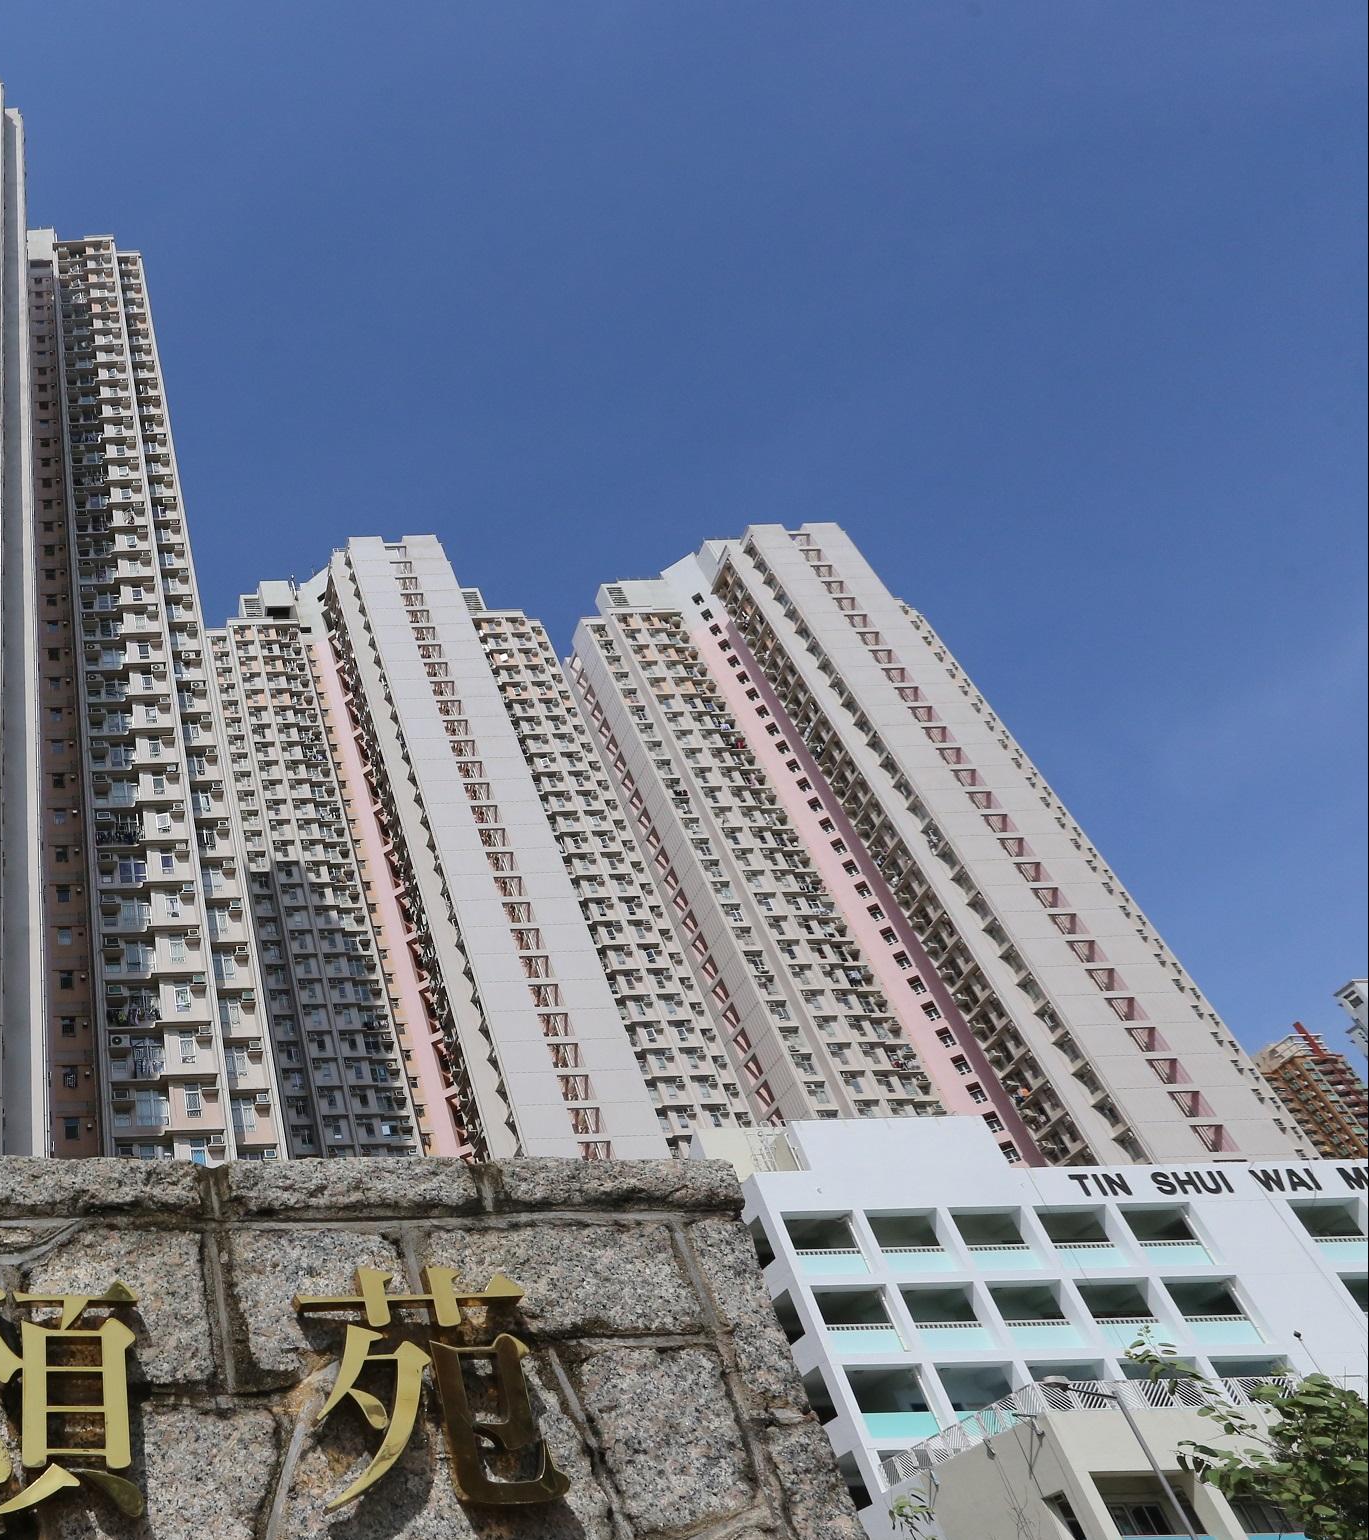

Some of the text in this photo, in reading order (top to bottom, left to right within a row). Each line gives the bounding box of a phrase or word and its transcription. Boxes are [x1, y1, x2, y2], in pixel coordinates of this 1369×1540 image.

[1068, 1166, 1368, 1196] TIN SHUI WAI M
